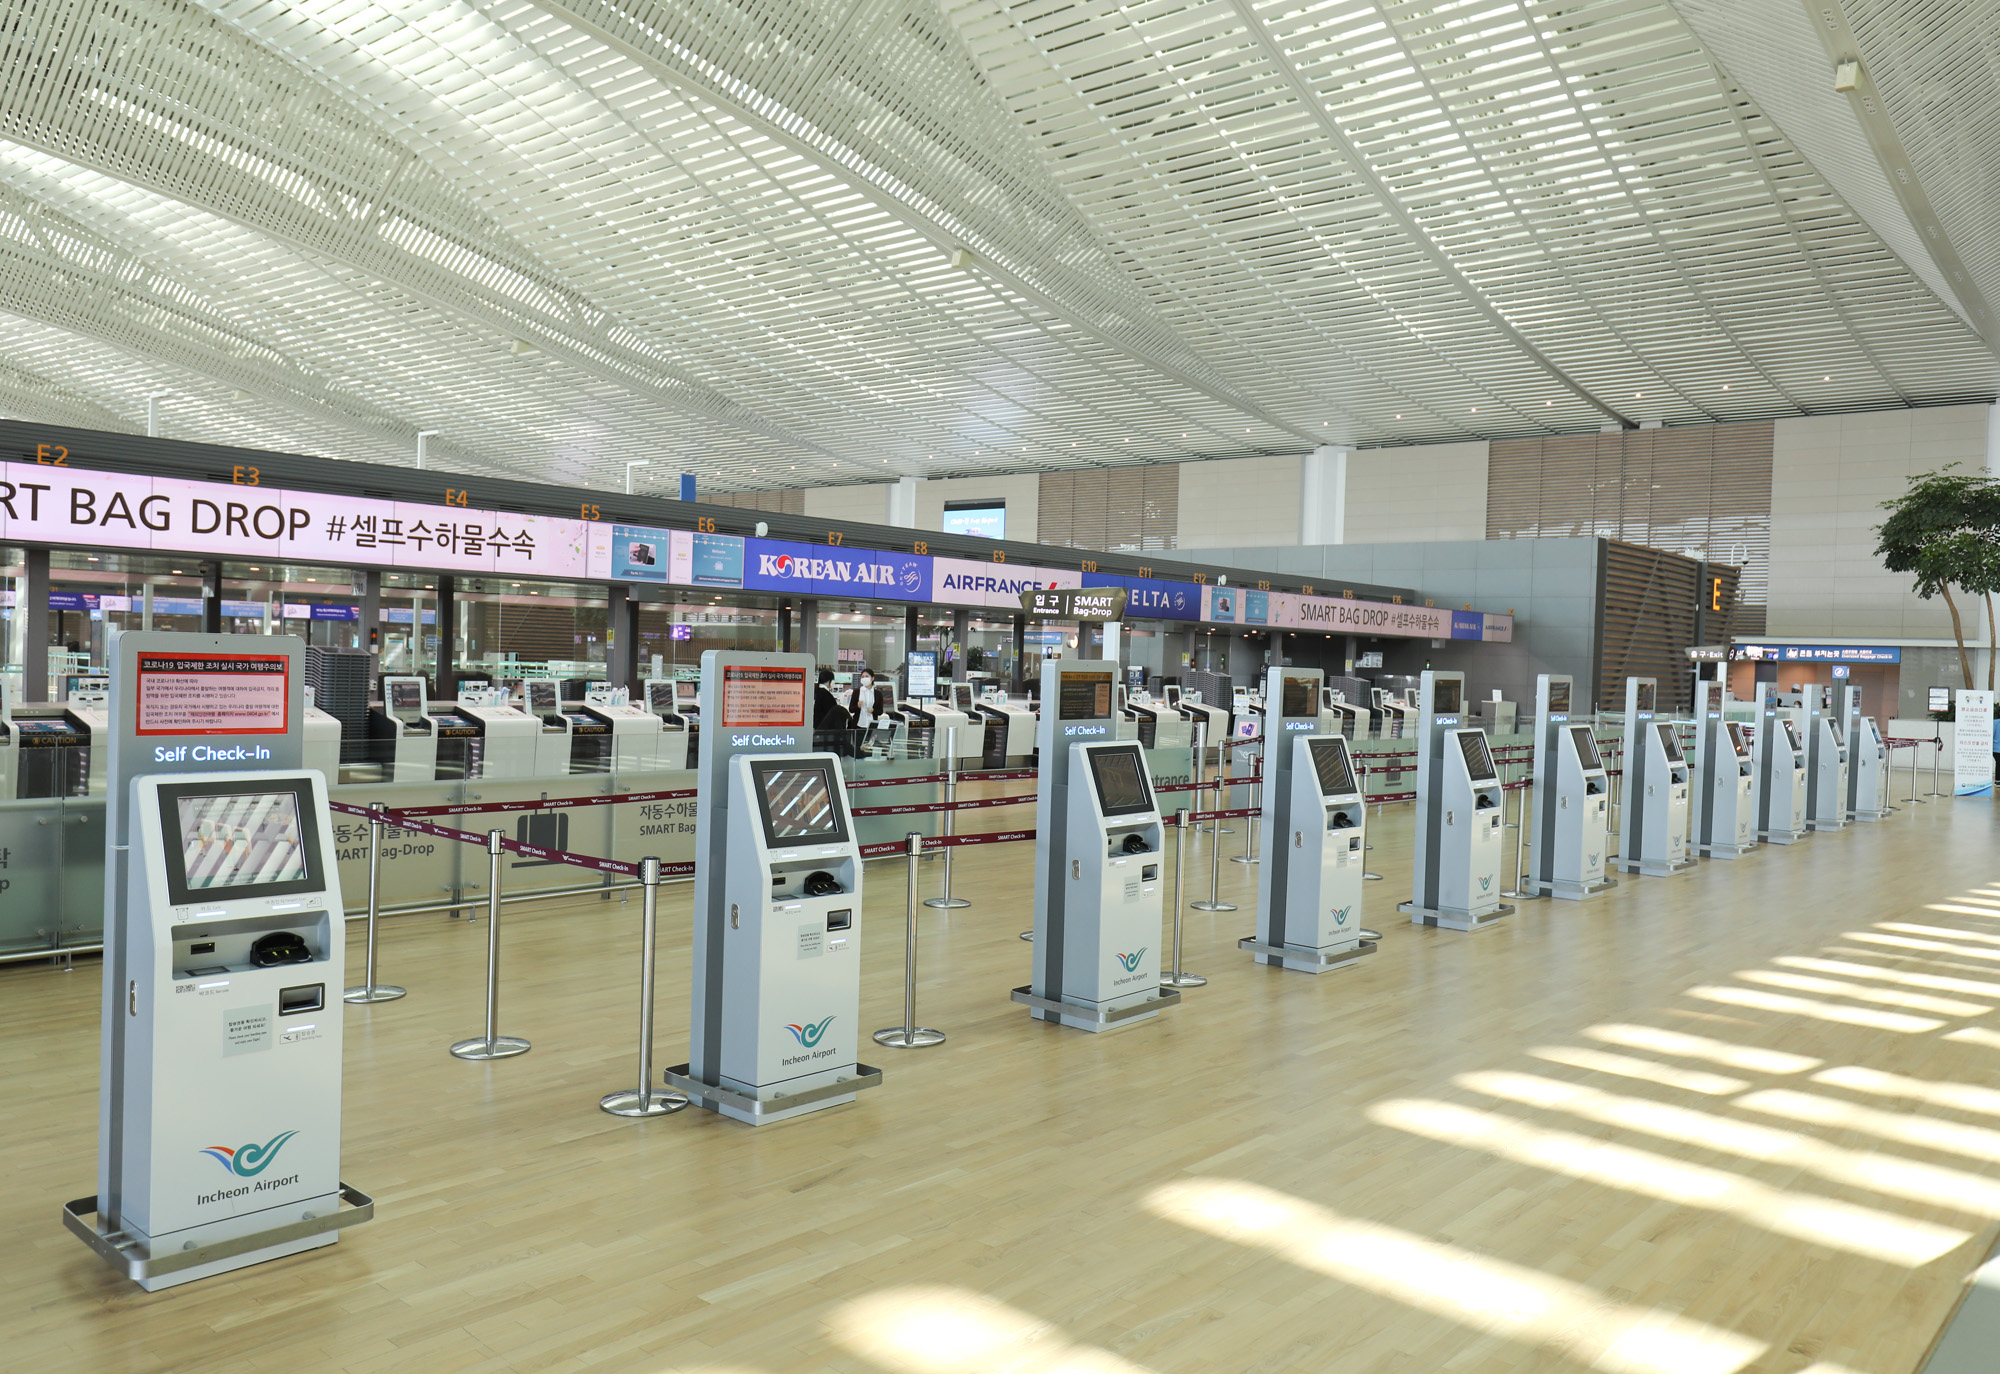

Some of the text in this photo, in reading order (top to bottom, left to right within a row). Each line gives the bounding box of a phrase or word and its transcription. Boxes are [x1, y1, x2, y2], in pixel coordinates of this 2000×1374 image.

[37, 444, 68, 467] E2
[233, 466, 260, 486] E3
[446, 488, 468, 507] E4
[581, 504, 600, 520] E5
[70, 488, 170, 531] BAG
[192, 499, 310, 540] DROP
[326, 514, 536, 560] #셀프수하물수속
[698, 517, 716, 533] E6
[828, 532, 843, 546] E7
[914, 541, 928, 554] E8
[993, 550, 1006, 563] E9
[759, 554, 896, 586] KOREAN AIR
[1082, 560, 1097, 572] E10
[1139, 566, 1152, 578] E11
[943, 574, 1042, 594] AIRFRANCE
[1194, 573, 1206, 584] E12
[1258, 580, 1270, 591] E13
[1302, 585, 1314, 595] E14
[1074, 596, 1113, 606] SMART
[1131, 590, 1170, 608] ELTA
[1343, 590, 1353, 600] E15
[1712, 578, 1721, 611] E
[1073, 607, 1112, 617] Bag-Drop
[1301, 603, 1336, 621] SMART
[1340, 607, 1359, 624] BAG
[1363, 609, 1389, 626] DROP
[177, 661, 204, 670] 입국제한
[206, 662, 219, 670] 조치
[221, 662, 234, 670] 실시
[1065, 726, 1106, 735] Self Check-In
[732, 734, 795, 746] Self Check-In
[155, 745, 270, 762] Self Check-In
[640, 823, 696, 836] SMART Bag
[381, 844, 434, 859] ag-Drop
[532, 847, 546, 856] Check-In
[612, 863, 629, 872] Check-In
[782, 1047, 836, 1066] Incheon Airport
[197, 1174, 299, 1205] Incheon Airport
